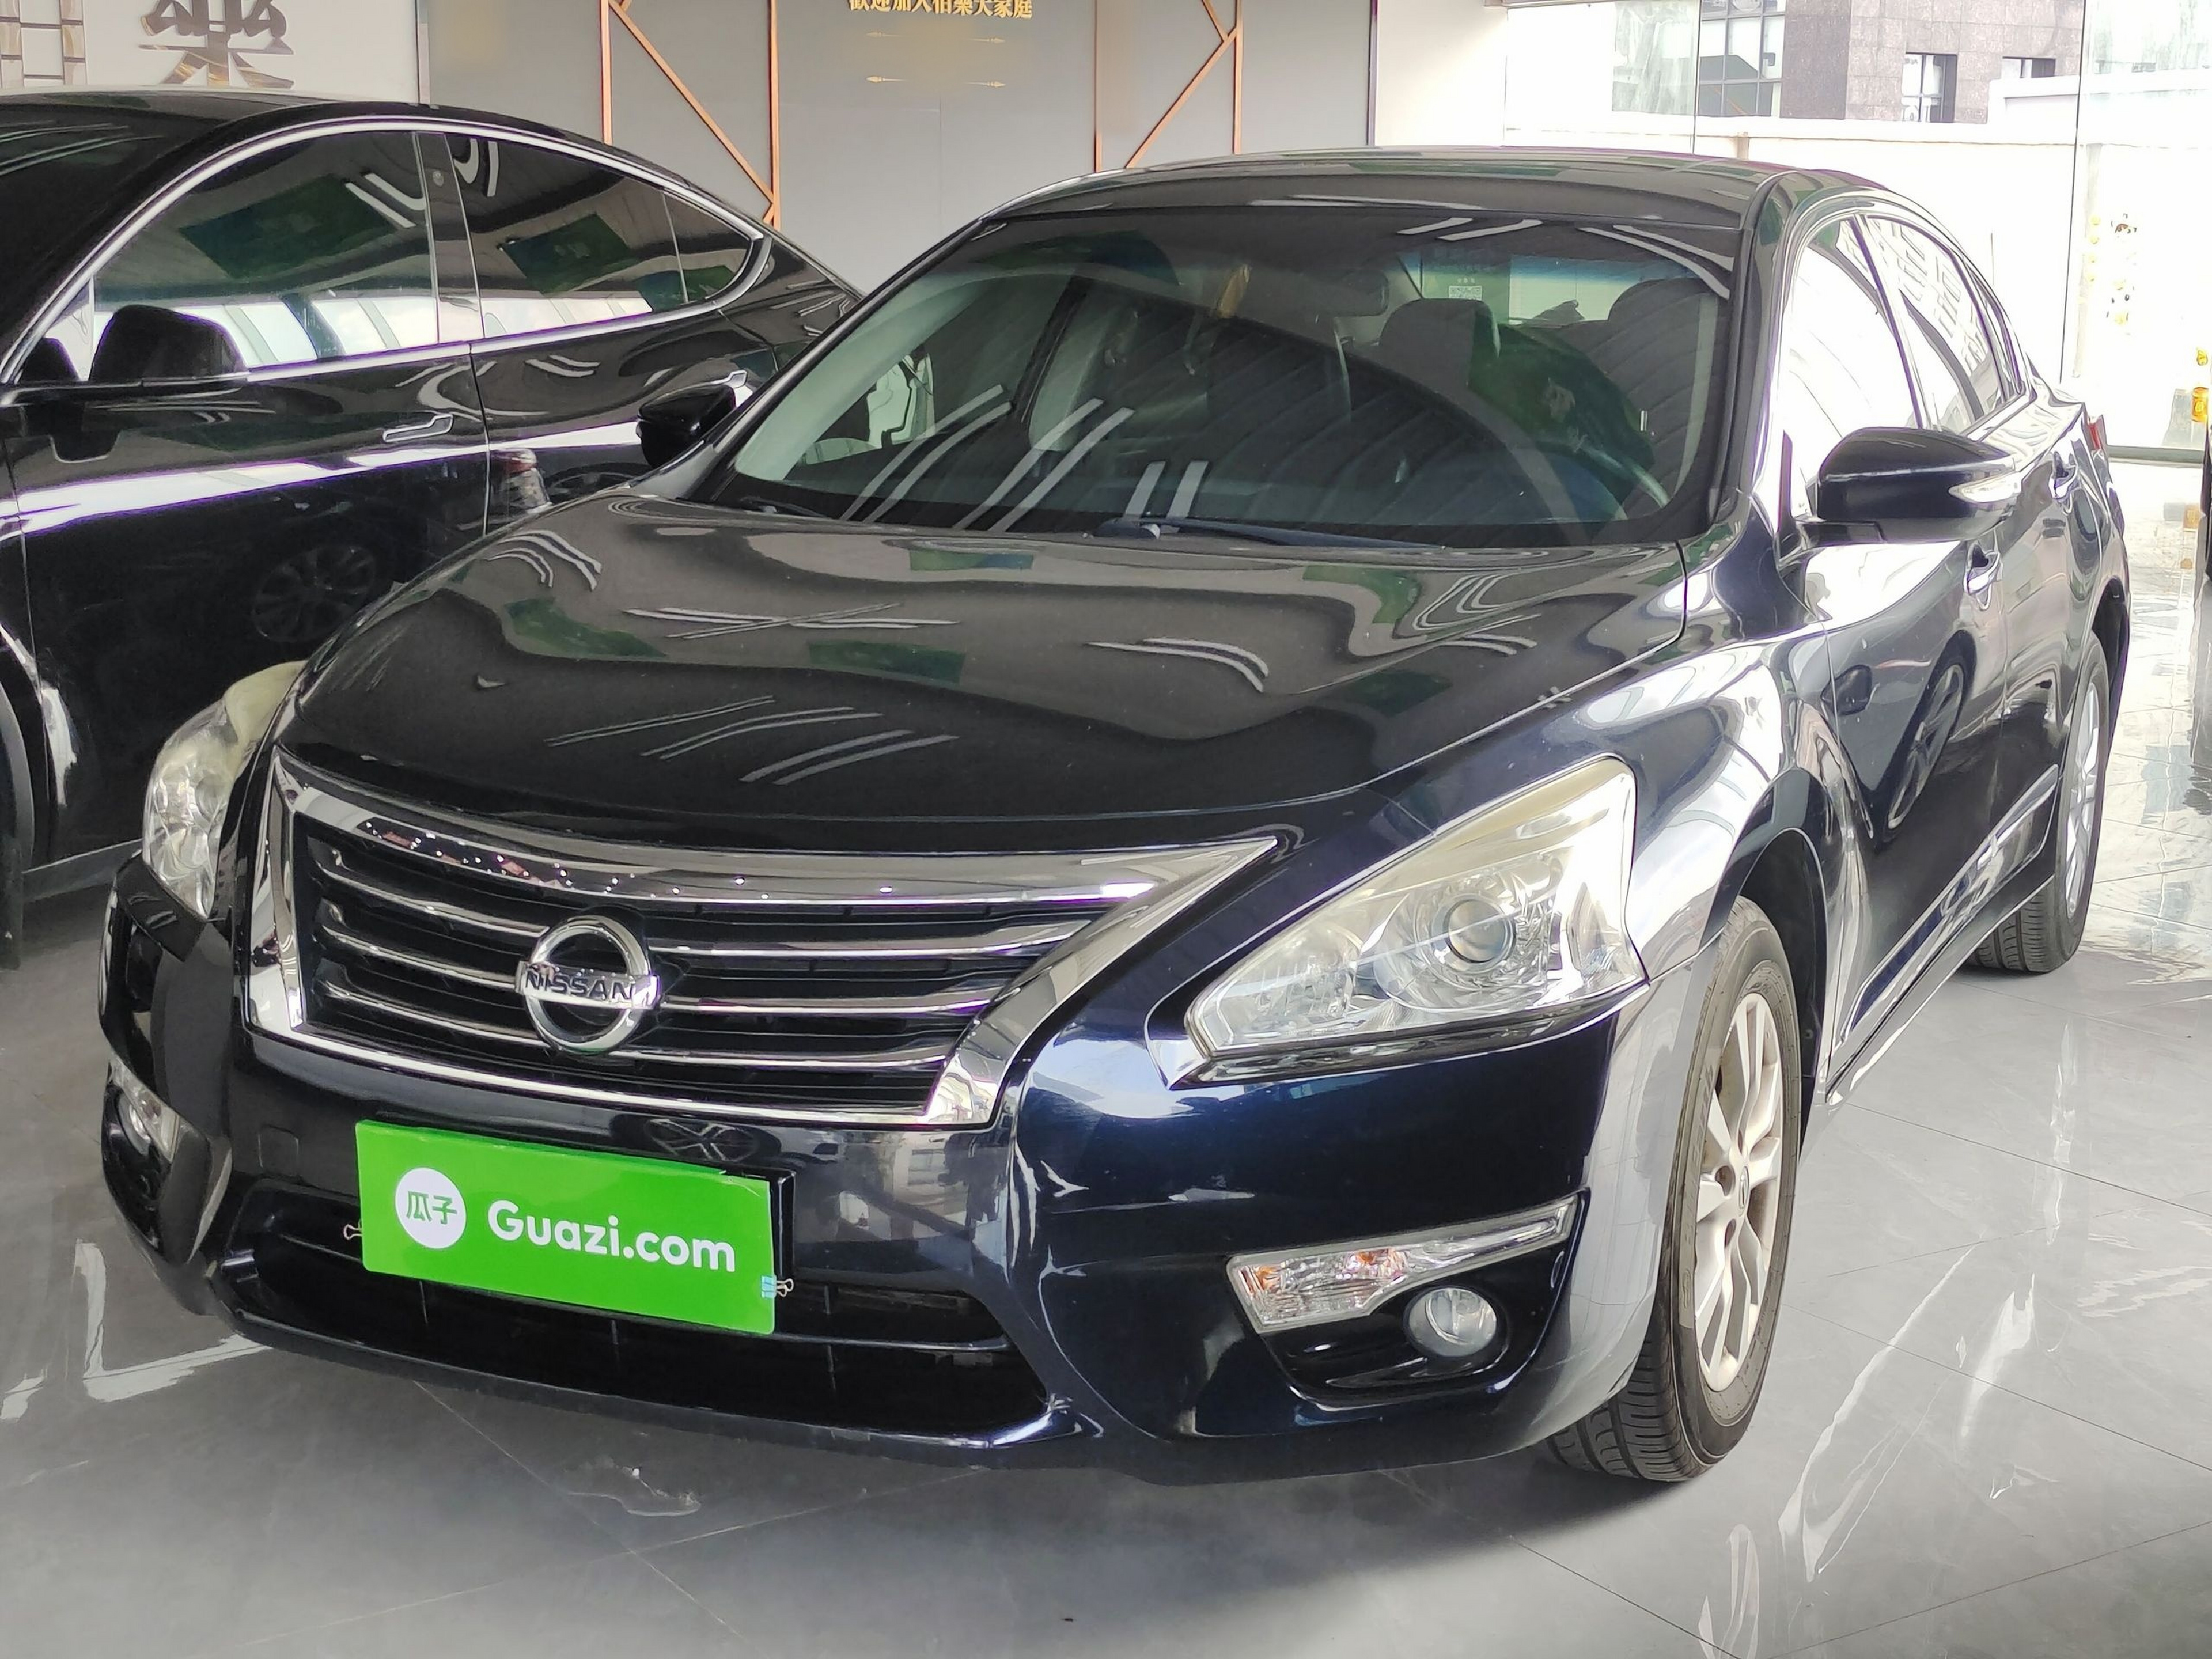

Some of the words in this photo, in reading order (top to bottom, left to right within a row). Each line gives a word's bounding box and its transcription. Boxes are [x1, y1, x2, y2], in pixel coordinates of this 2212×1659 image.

[525, 967, 635, 1001] NISSAN
[406, 1191, 457, 1224] 瓜子
[487, 1200, 735, 1272] Guazi.com
